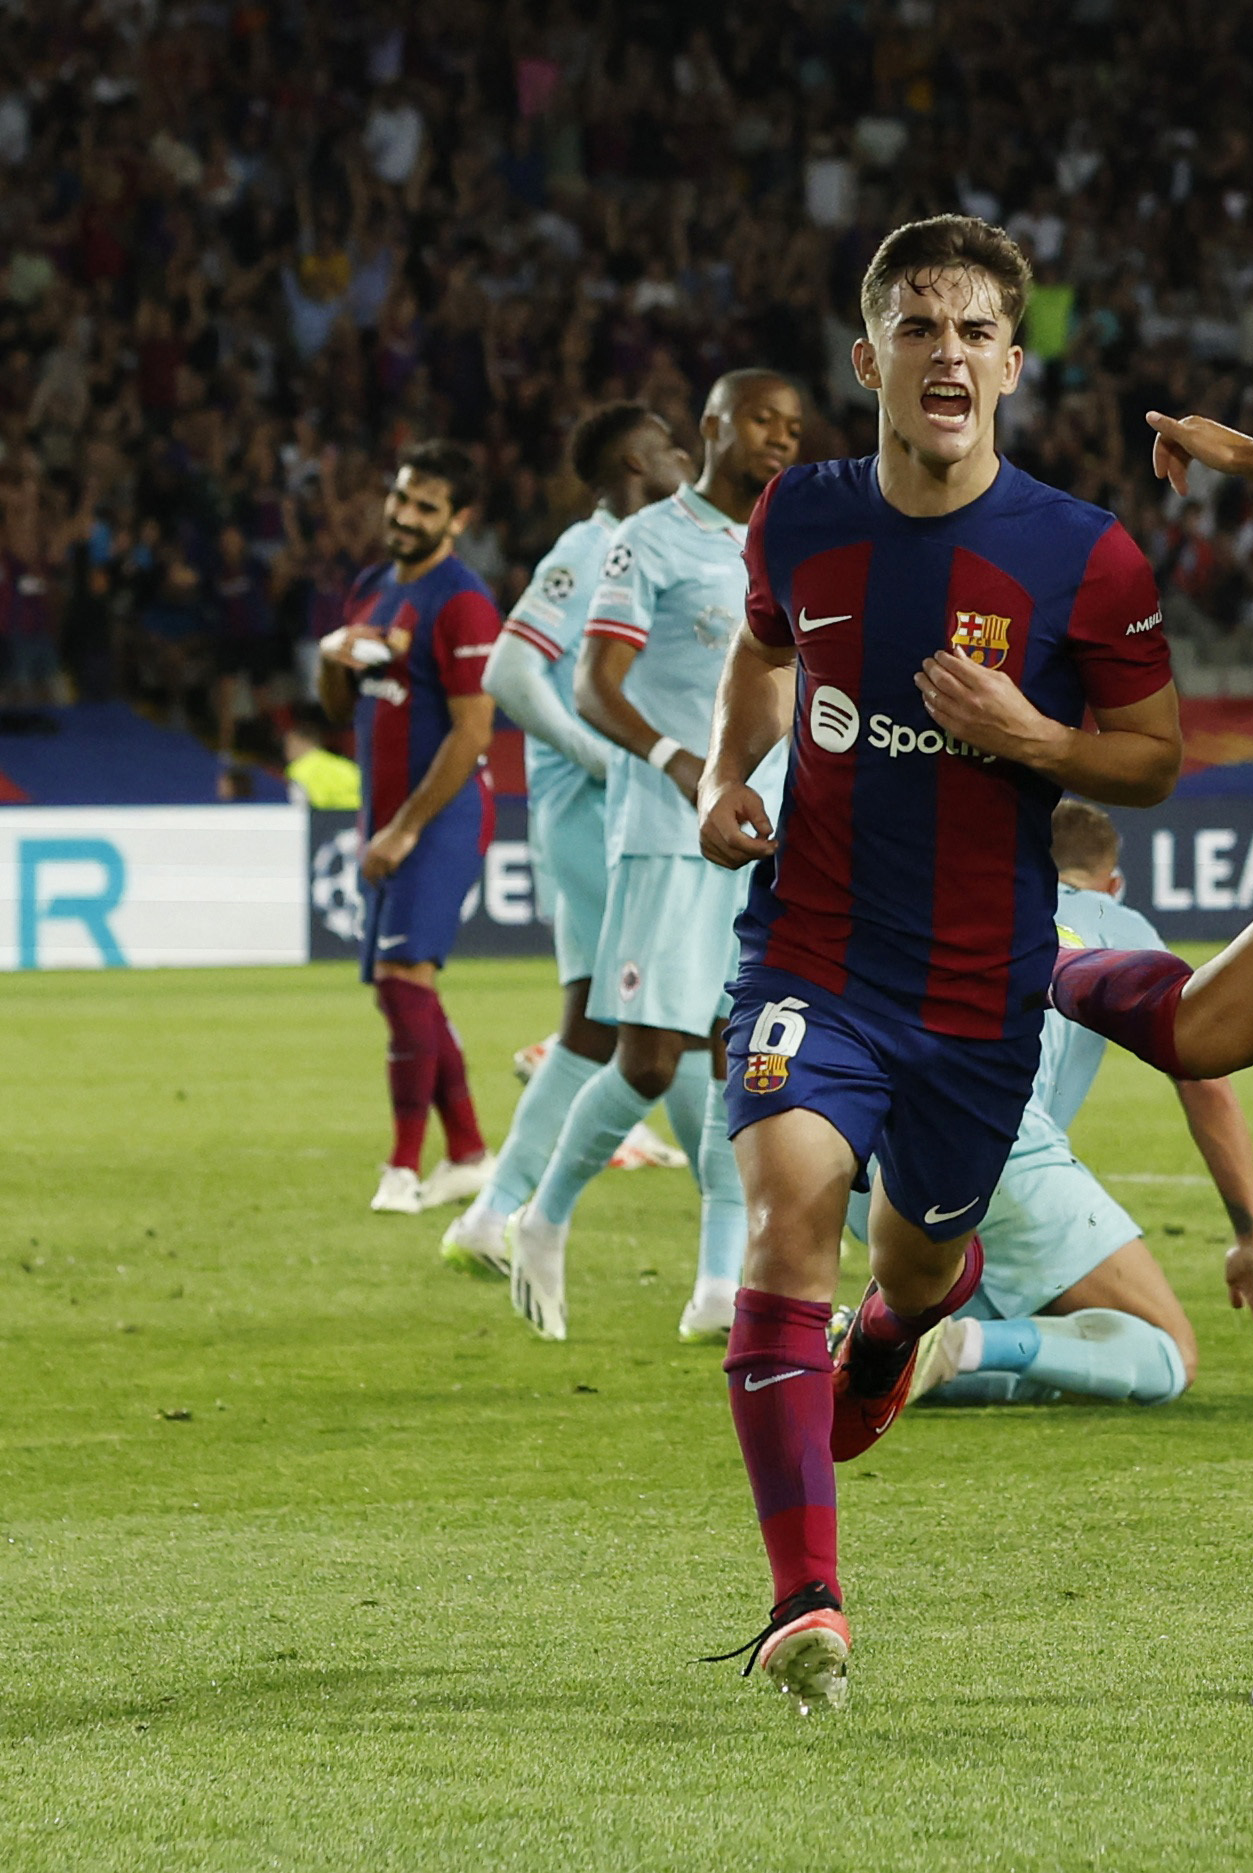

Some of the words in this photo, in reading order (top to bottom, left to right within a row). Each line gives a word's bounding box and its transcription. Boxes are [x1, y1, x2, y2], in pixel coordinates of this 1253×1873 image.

[867, 713, 997, 764] Spot
[18, 838, 131, 970] R
[748, 996, 810, 1058] 6
